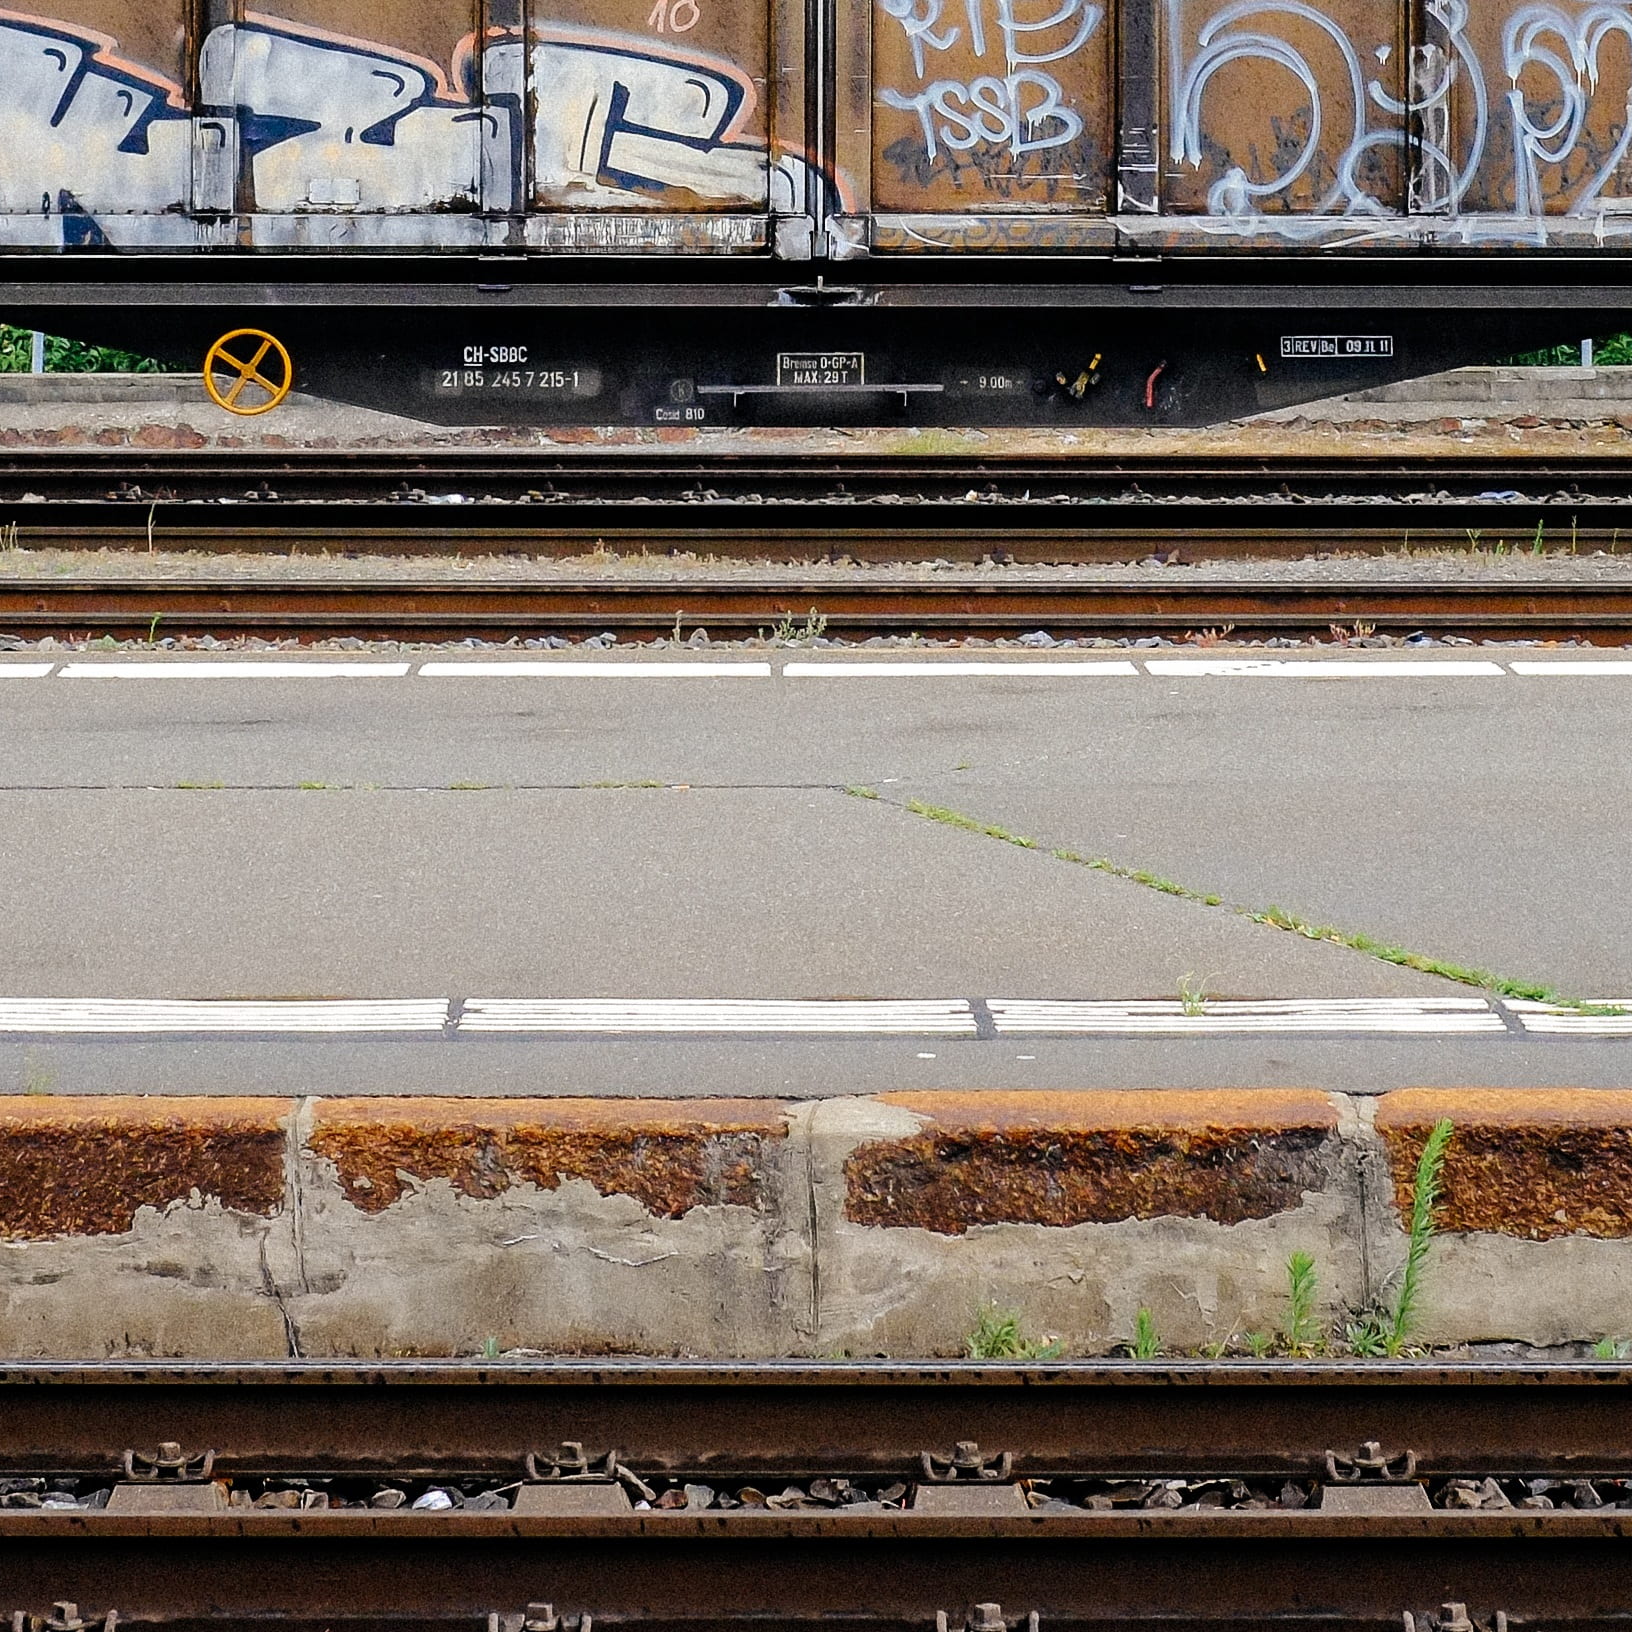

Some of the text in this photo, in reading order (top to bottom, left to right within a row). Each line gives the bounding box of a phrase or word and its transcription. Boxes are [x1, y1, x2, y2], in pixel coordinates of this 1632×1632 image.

[1283, 340, 1291, 353] 3
[1295, 340, 1317, 353] REV
[463, 346, 528, 366] CH-SBBC
[441, 371, 458, 387] 21
[464, 371, 484, 387] 85
[539, 371, 579, 387] 215-1
[685, 407, 705, 420] 810
